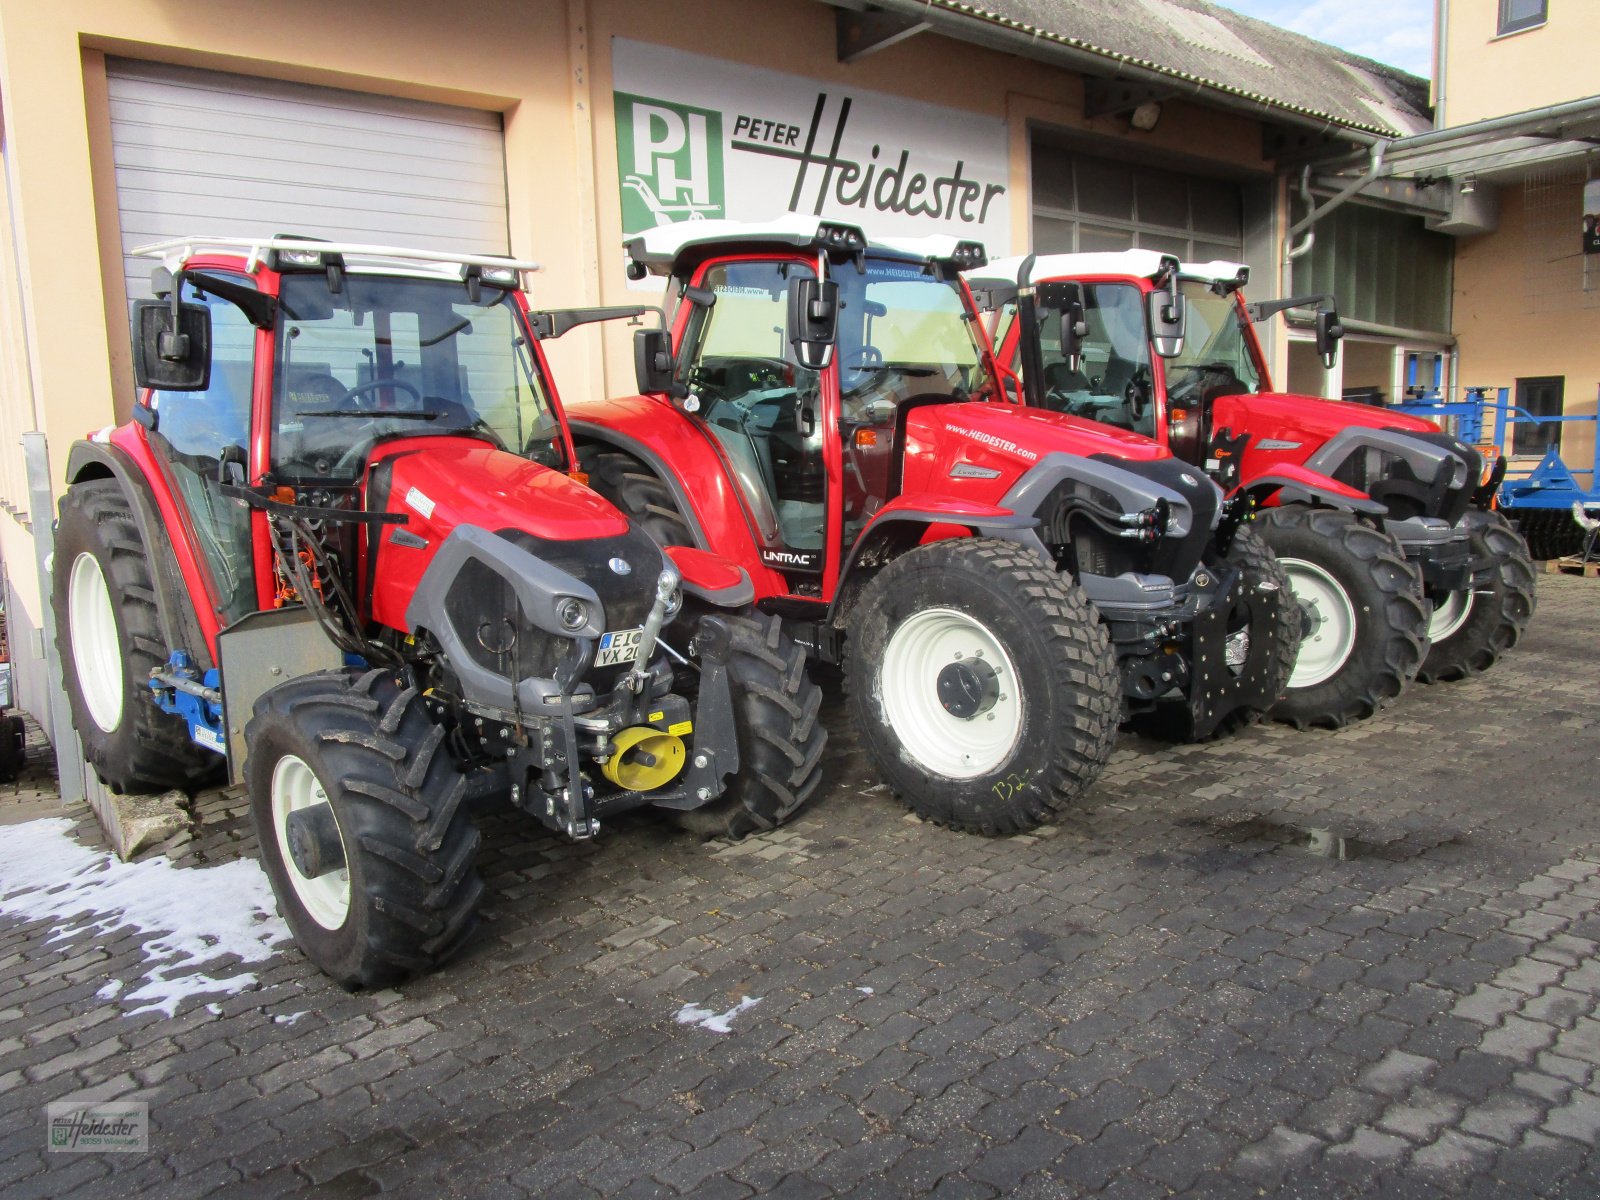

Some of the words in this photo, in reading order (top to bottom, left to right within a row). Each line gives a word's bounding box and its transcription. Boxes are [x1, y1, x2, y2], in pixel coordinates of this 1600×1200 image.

[732, 114, 801, 147] PETER
[788, 92, 1006, 225] Heidester
[945, 423, 1038, 461] www.HEIDESTER.com
[763, 550, 810, 565] LINTRAC
